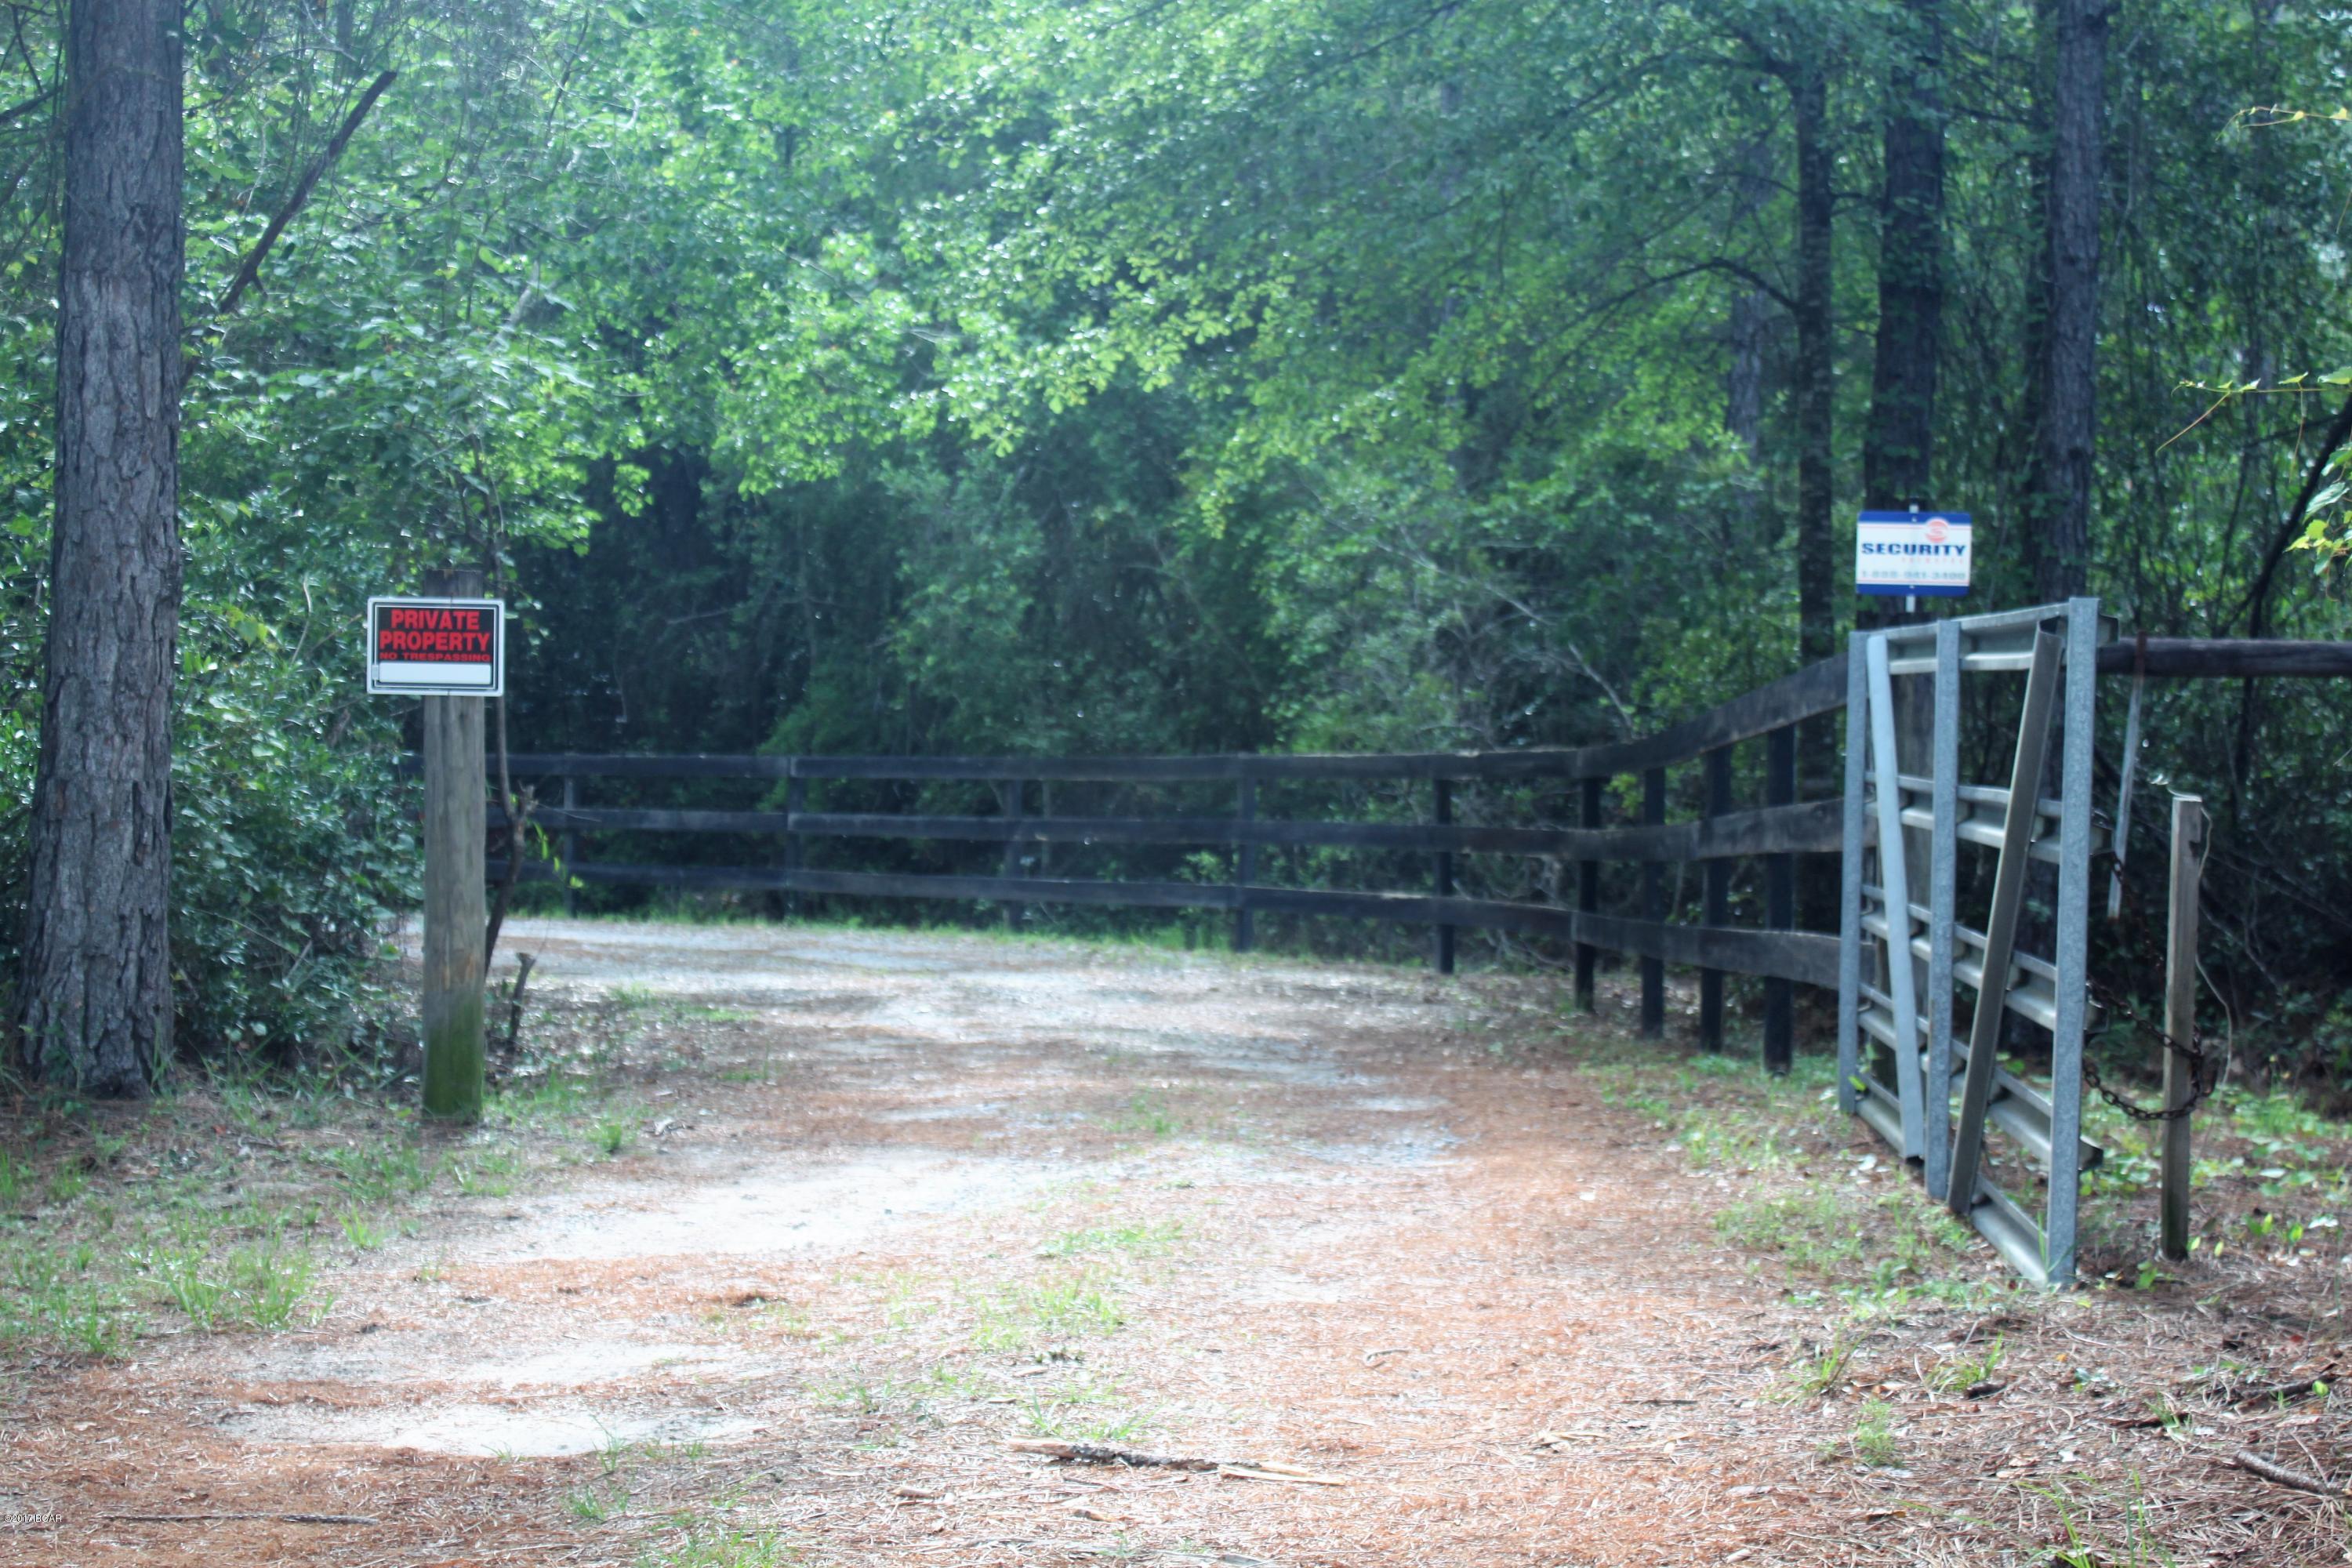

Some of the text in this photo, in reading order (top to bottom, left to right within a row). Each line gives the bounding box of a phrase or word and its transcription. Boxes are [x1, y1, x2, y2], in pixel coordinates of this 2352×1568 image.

[1861, 543, 1966, 556] SECURITY
[390, 609, 481, 630] PRIVATE
[379, 630, 490, 652] PROPERTY
[379, 652, 491, 662] NO TRESPASSING
